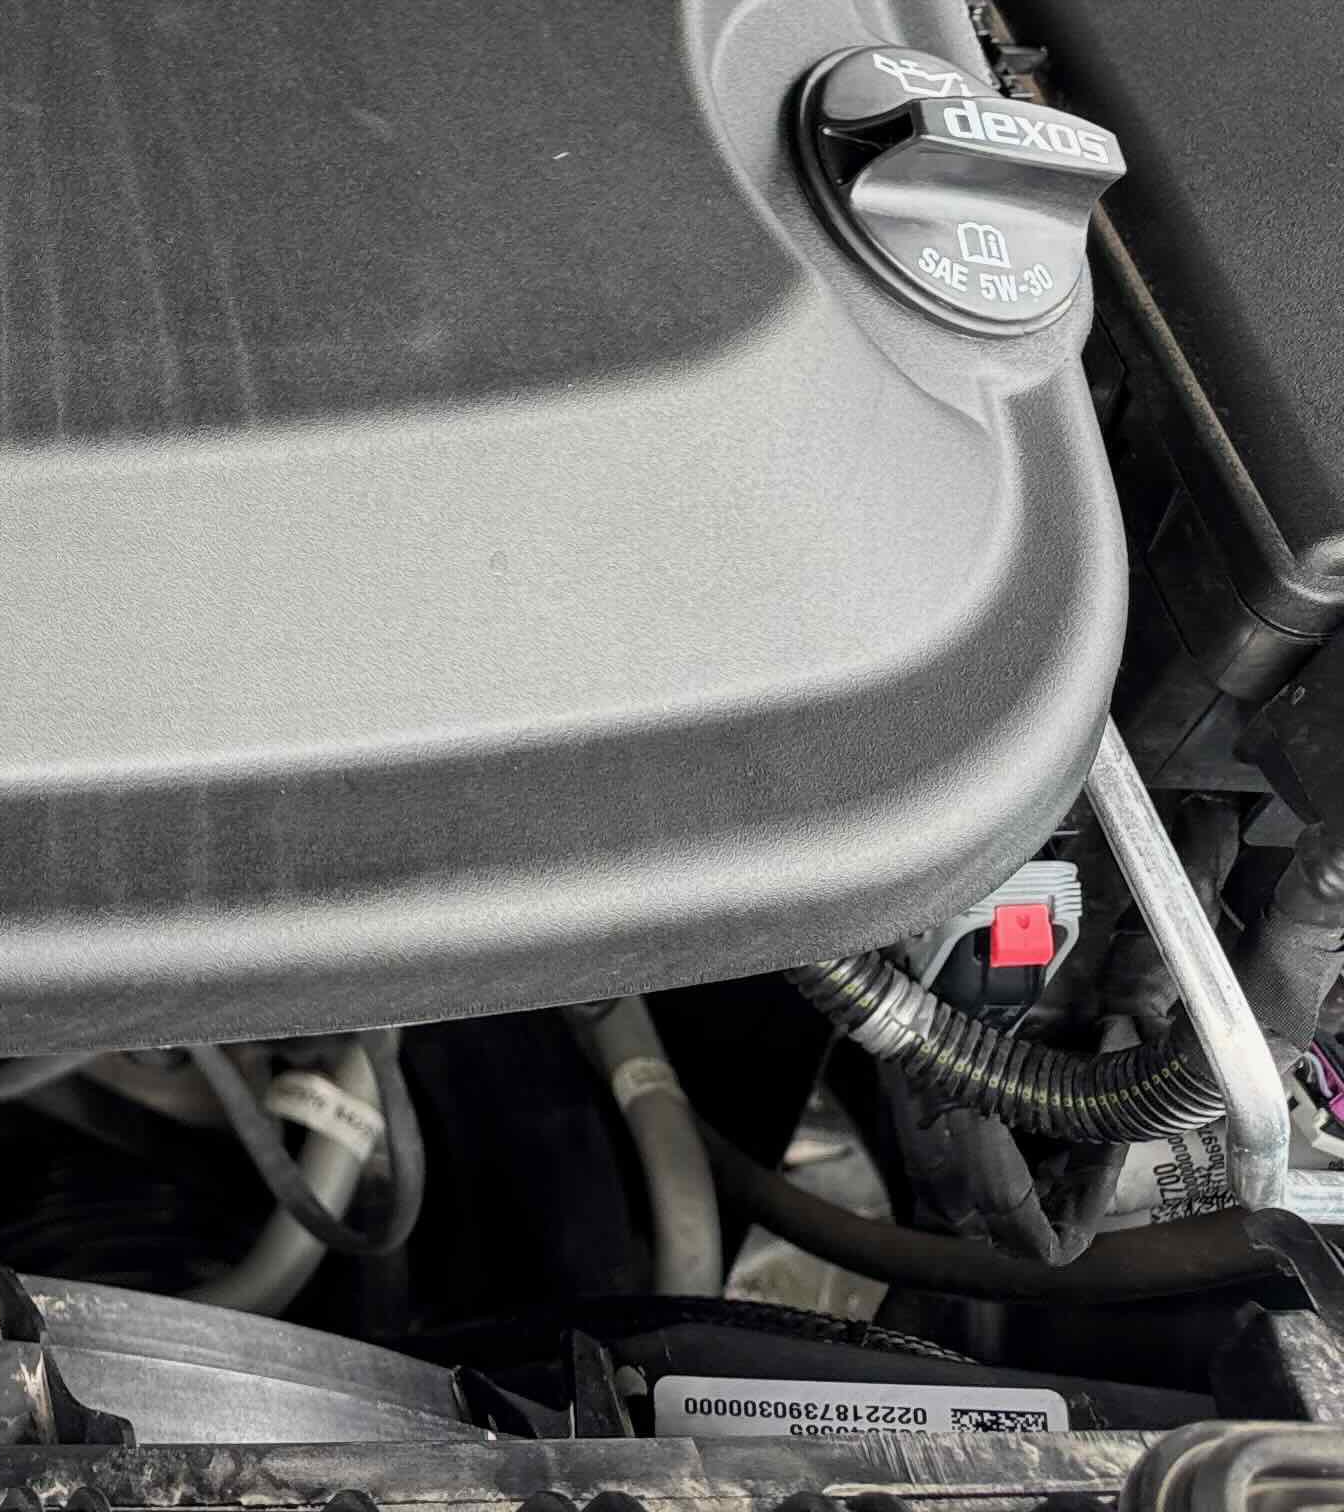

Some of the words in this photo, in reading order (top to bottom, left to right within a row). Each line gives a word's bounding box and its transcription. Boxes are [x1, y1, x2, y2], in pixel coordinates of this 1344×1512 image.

[943, 99, 1109, 164] dexos
[918, 247, 969, 293] SAE
[979, 263, 1054, 302] 5W-30
